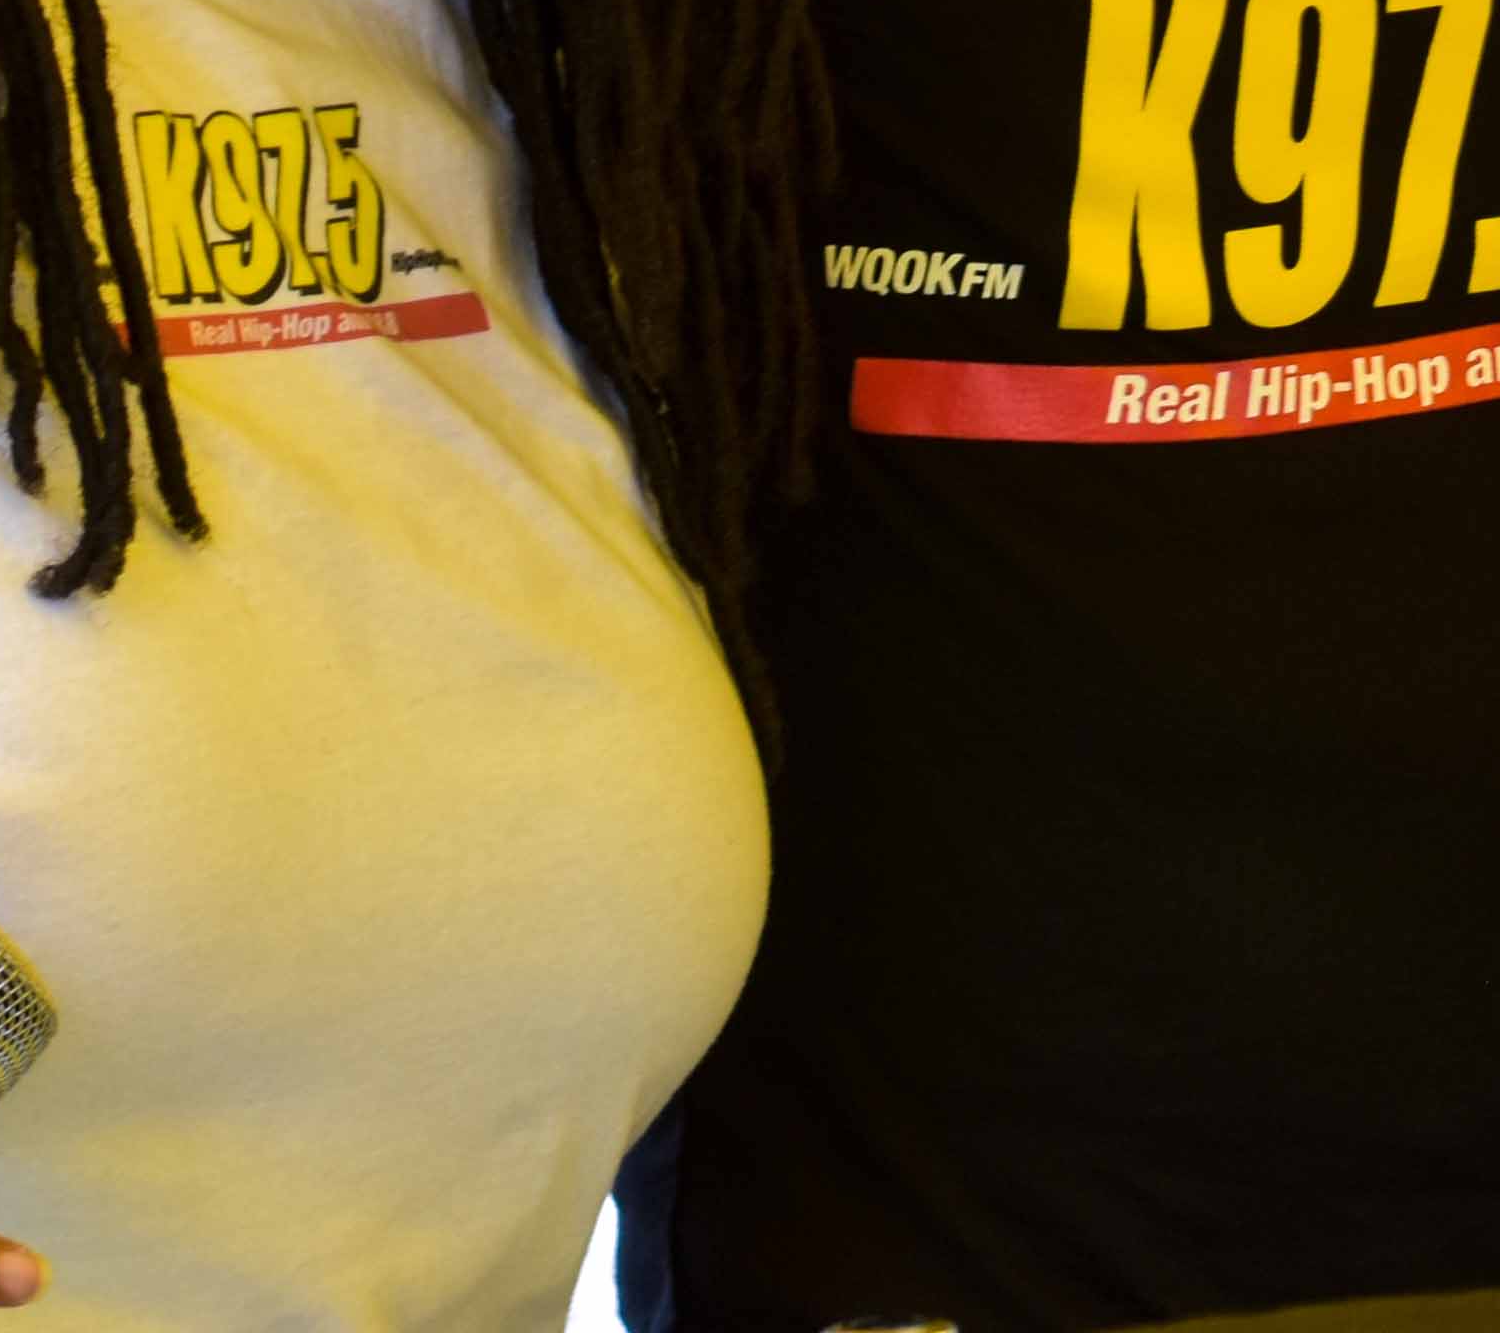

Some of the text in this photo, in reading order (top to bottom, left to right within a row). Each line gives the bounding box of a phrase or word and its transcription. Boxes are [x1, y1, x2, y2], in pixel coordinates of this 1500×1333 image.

[134, 102, 386, 305] K97.5
[188, 318, 237, 347] Real
[239, 312, 332, 348] Hip-Hop
[1106, 370, 1231, 425] Real
[1246, 353, 1450, 425] Hip-Hop
